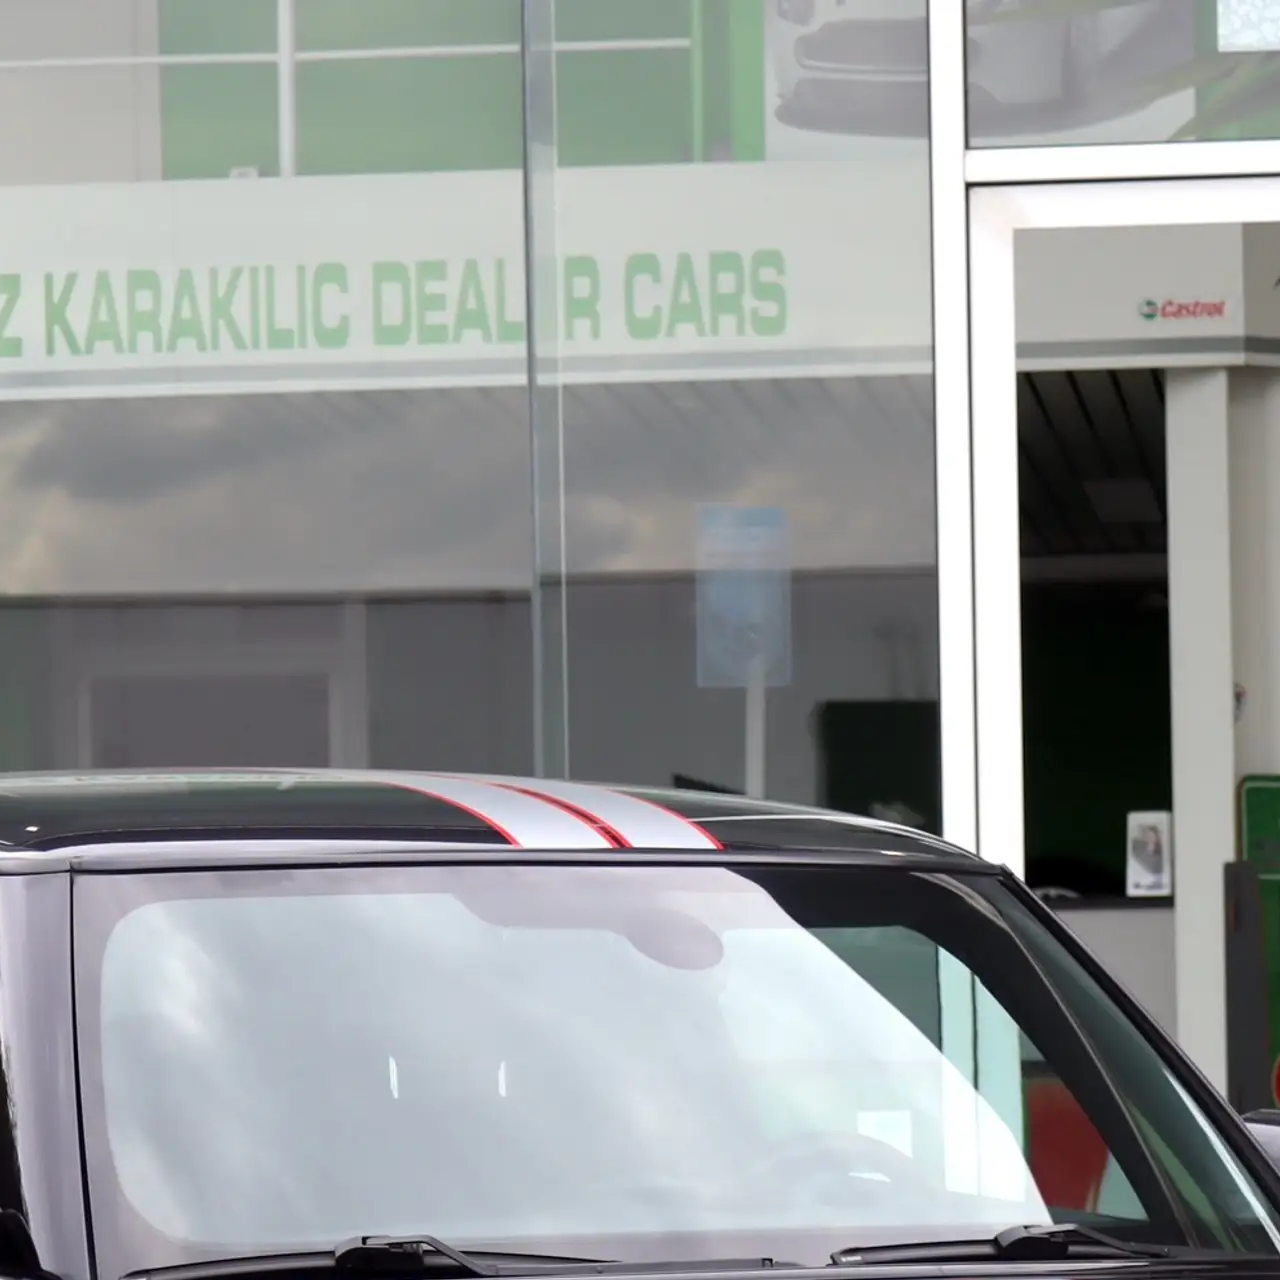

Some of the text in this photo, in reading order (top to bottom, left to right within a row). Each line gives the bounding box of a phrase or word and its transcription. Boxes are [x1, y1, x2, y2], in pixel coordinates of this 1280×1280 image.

[43, 262, 350, 358] KARAKILIC
[371, 255, 601, 346] DEALR
[624, 249, 788, 341] CARS
